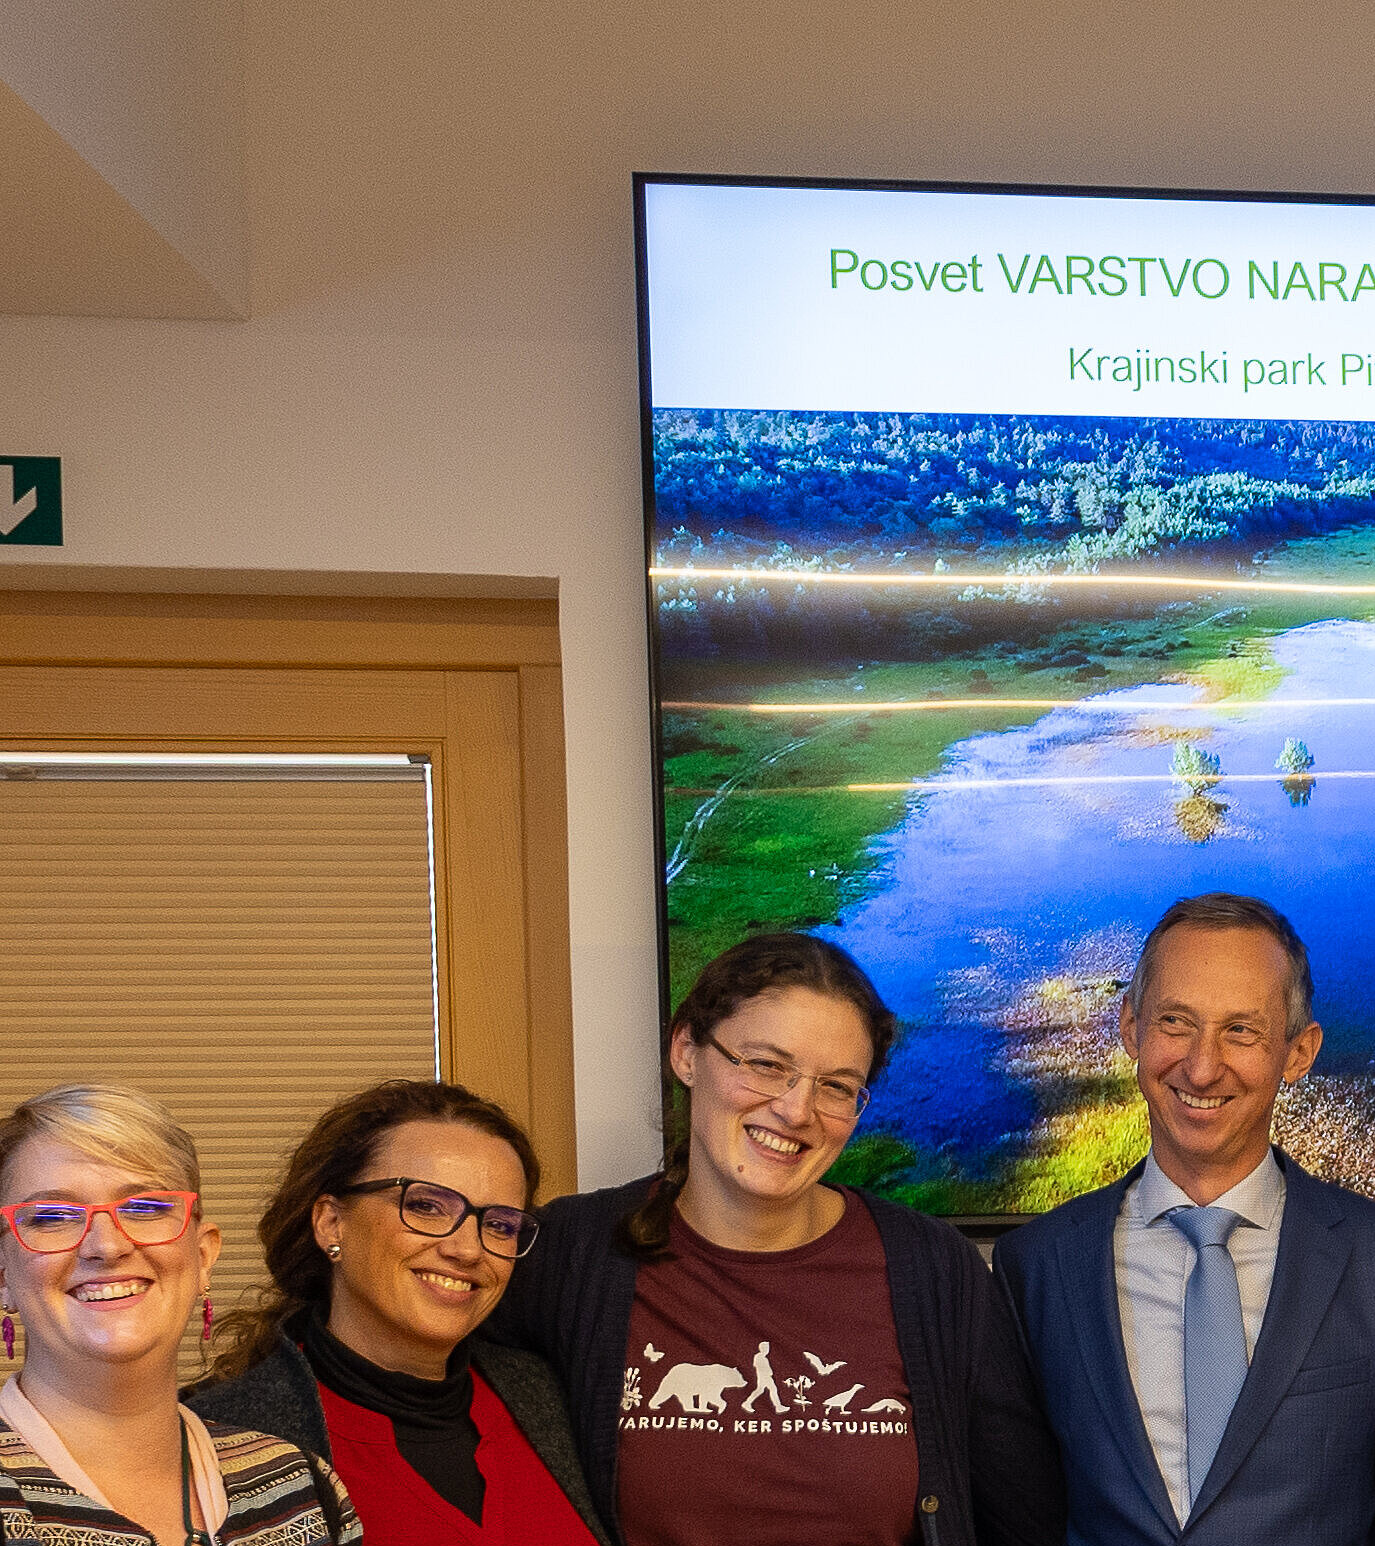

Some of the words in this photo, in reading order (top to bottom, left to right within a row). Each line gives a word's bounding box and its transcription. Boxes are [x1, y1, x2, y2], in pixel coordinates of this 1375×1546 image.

[829, 247, 985, 294] Posvet
[996, 252, 1230, 300] VARSTVO
[1069, 346, 1228, 393] Krajinski
[1243, 352, 1327, 394] park
[734, 1420, 772, 1433] KER
[782, 1416, 908, 1435] SPOŠTUJEMO!
